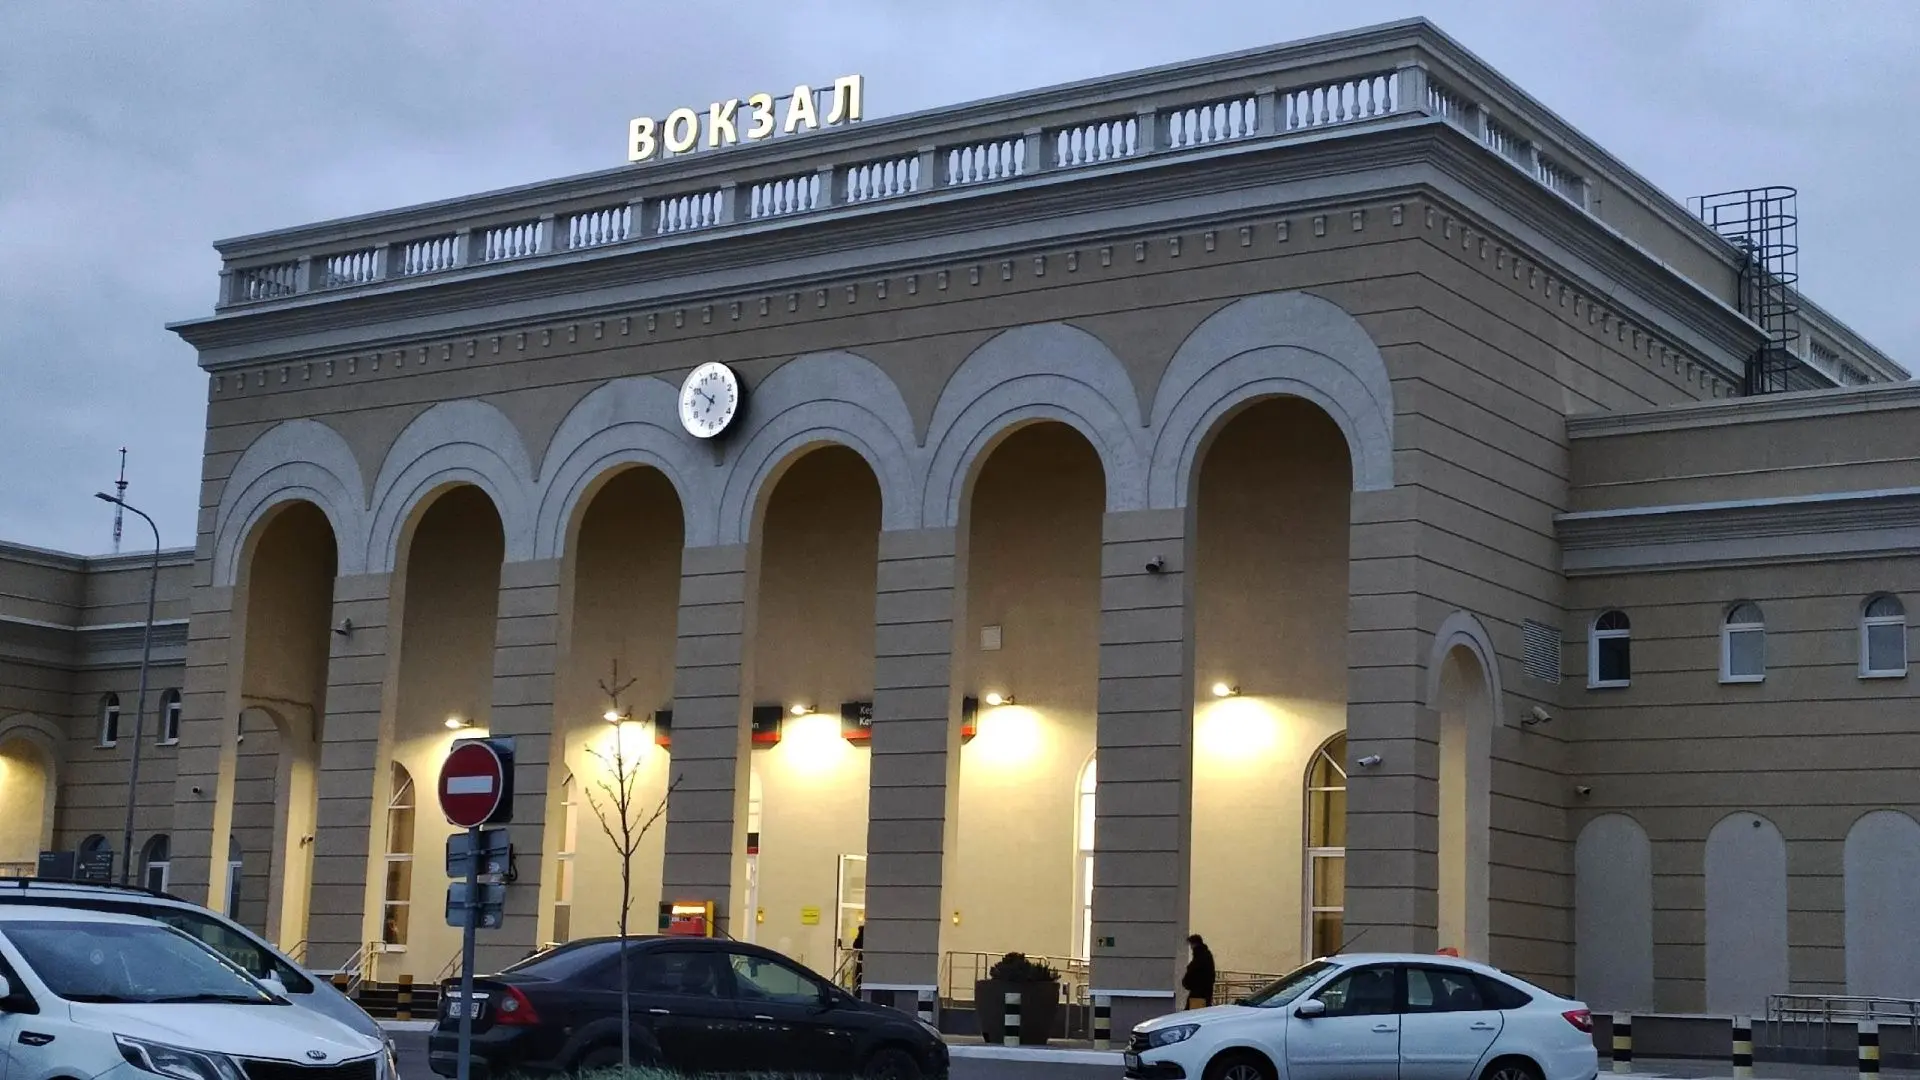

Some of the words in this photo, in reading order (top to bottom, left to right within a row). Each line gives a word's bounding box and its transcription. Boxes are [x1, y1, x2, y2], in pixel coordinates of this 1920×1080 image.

[628, 74, 864, 162] ВОКЗАЛ
[701, 377, 708, 385] 11
[721, 375, 725, 383] 1
[727, 383, 732, 391] 2
[729, 394, 734, 403] 3
[691, 399, 696, 407] 9
[700, 419, 705, 427] 7
[719, 417, 724, 425] 5
[709, 422, 714, 430] 6
